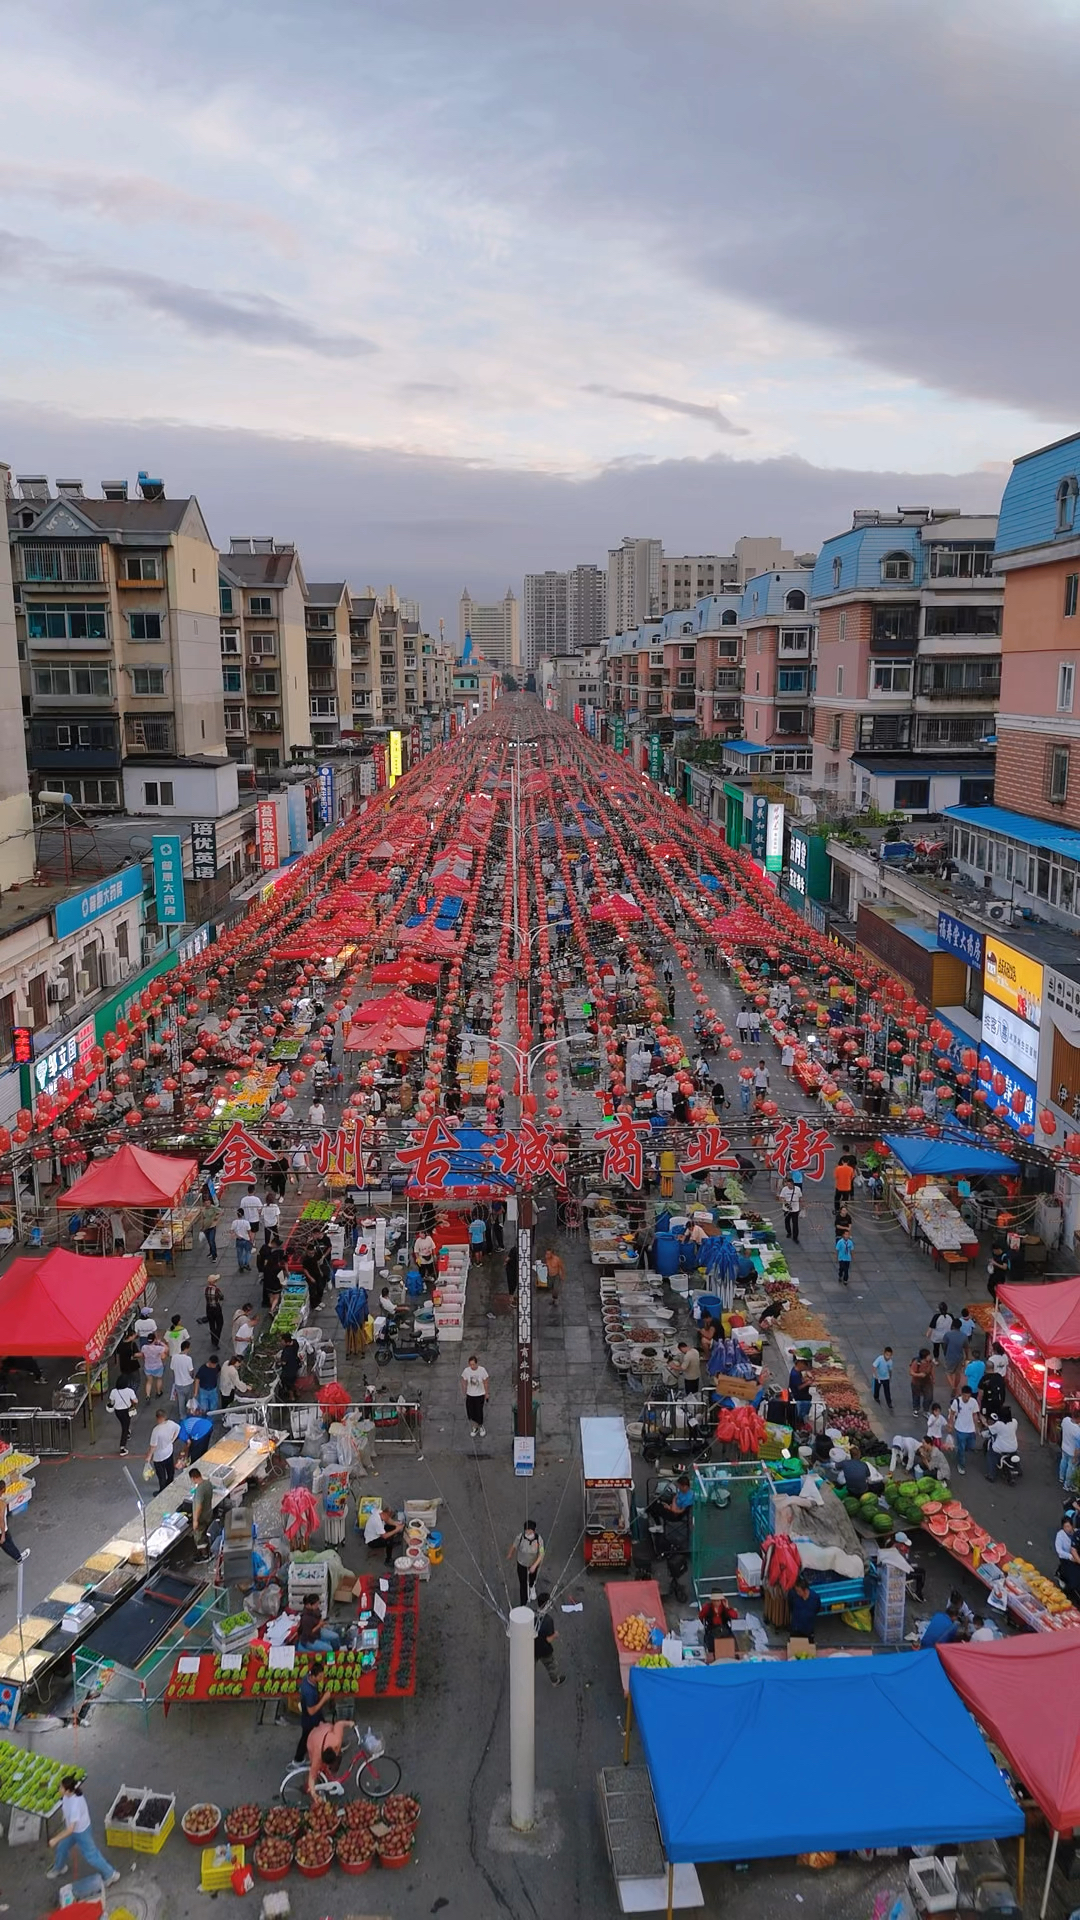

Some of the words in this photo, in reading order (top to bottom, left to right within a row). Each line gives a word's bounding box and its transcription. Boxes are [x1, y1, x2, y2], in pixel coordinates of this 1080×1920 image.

[193, 823, 215, 879] 培优英语
[261, 805, 275, 866] 益民堂药房
[939, 918, 982, 962] 福寿堂大药房
[203, 1113, 835, 1191] 金州古城商业街
[519, 1347, 530, 1382] 商业街
